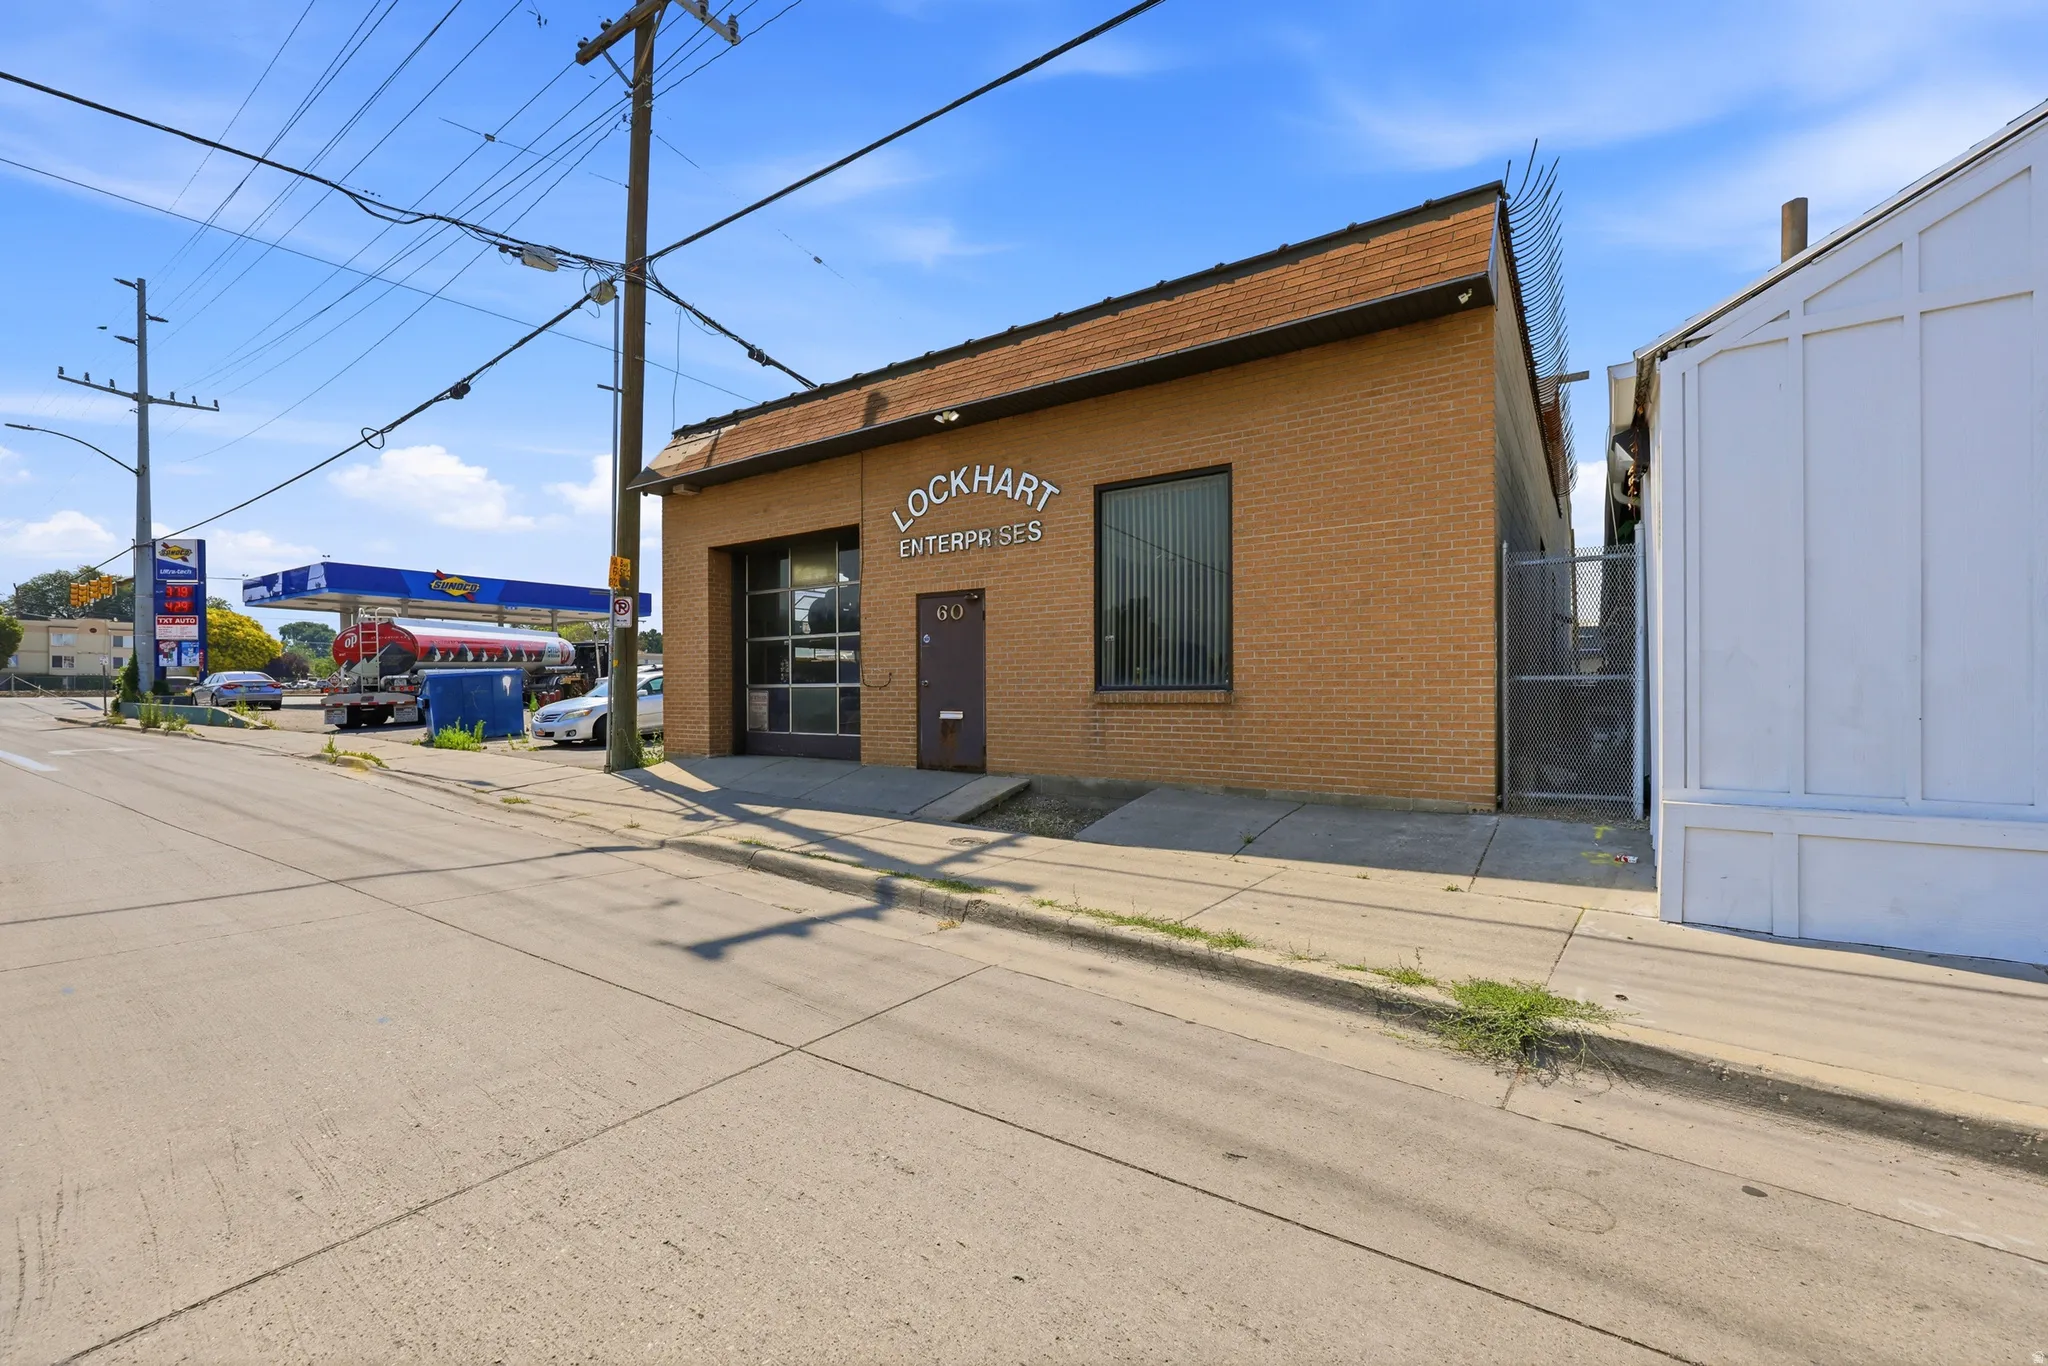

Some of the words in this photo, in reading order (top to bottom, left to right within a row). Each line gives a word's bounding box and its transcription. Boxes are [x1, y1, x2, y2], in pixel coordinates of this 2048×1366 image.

[891, 464, 1061, 533] LOCKHART
[900, 520, 1042, 558] ENTERPRSES
[433, 581, 479, 593] SUNOCO
[936, 603, 964, 621] 60
